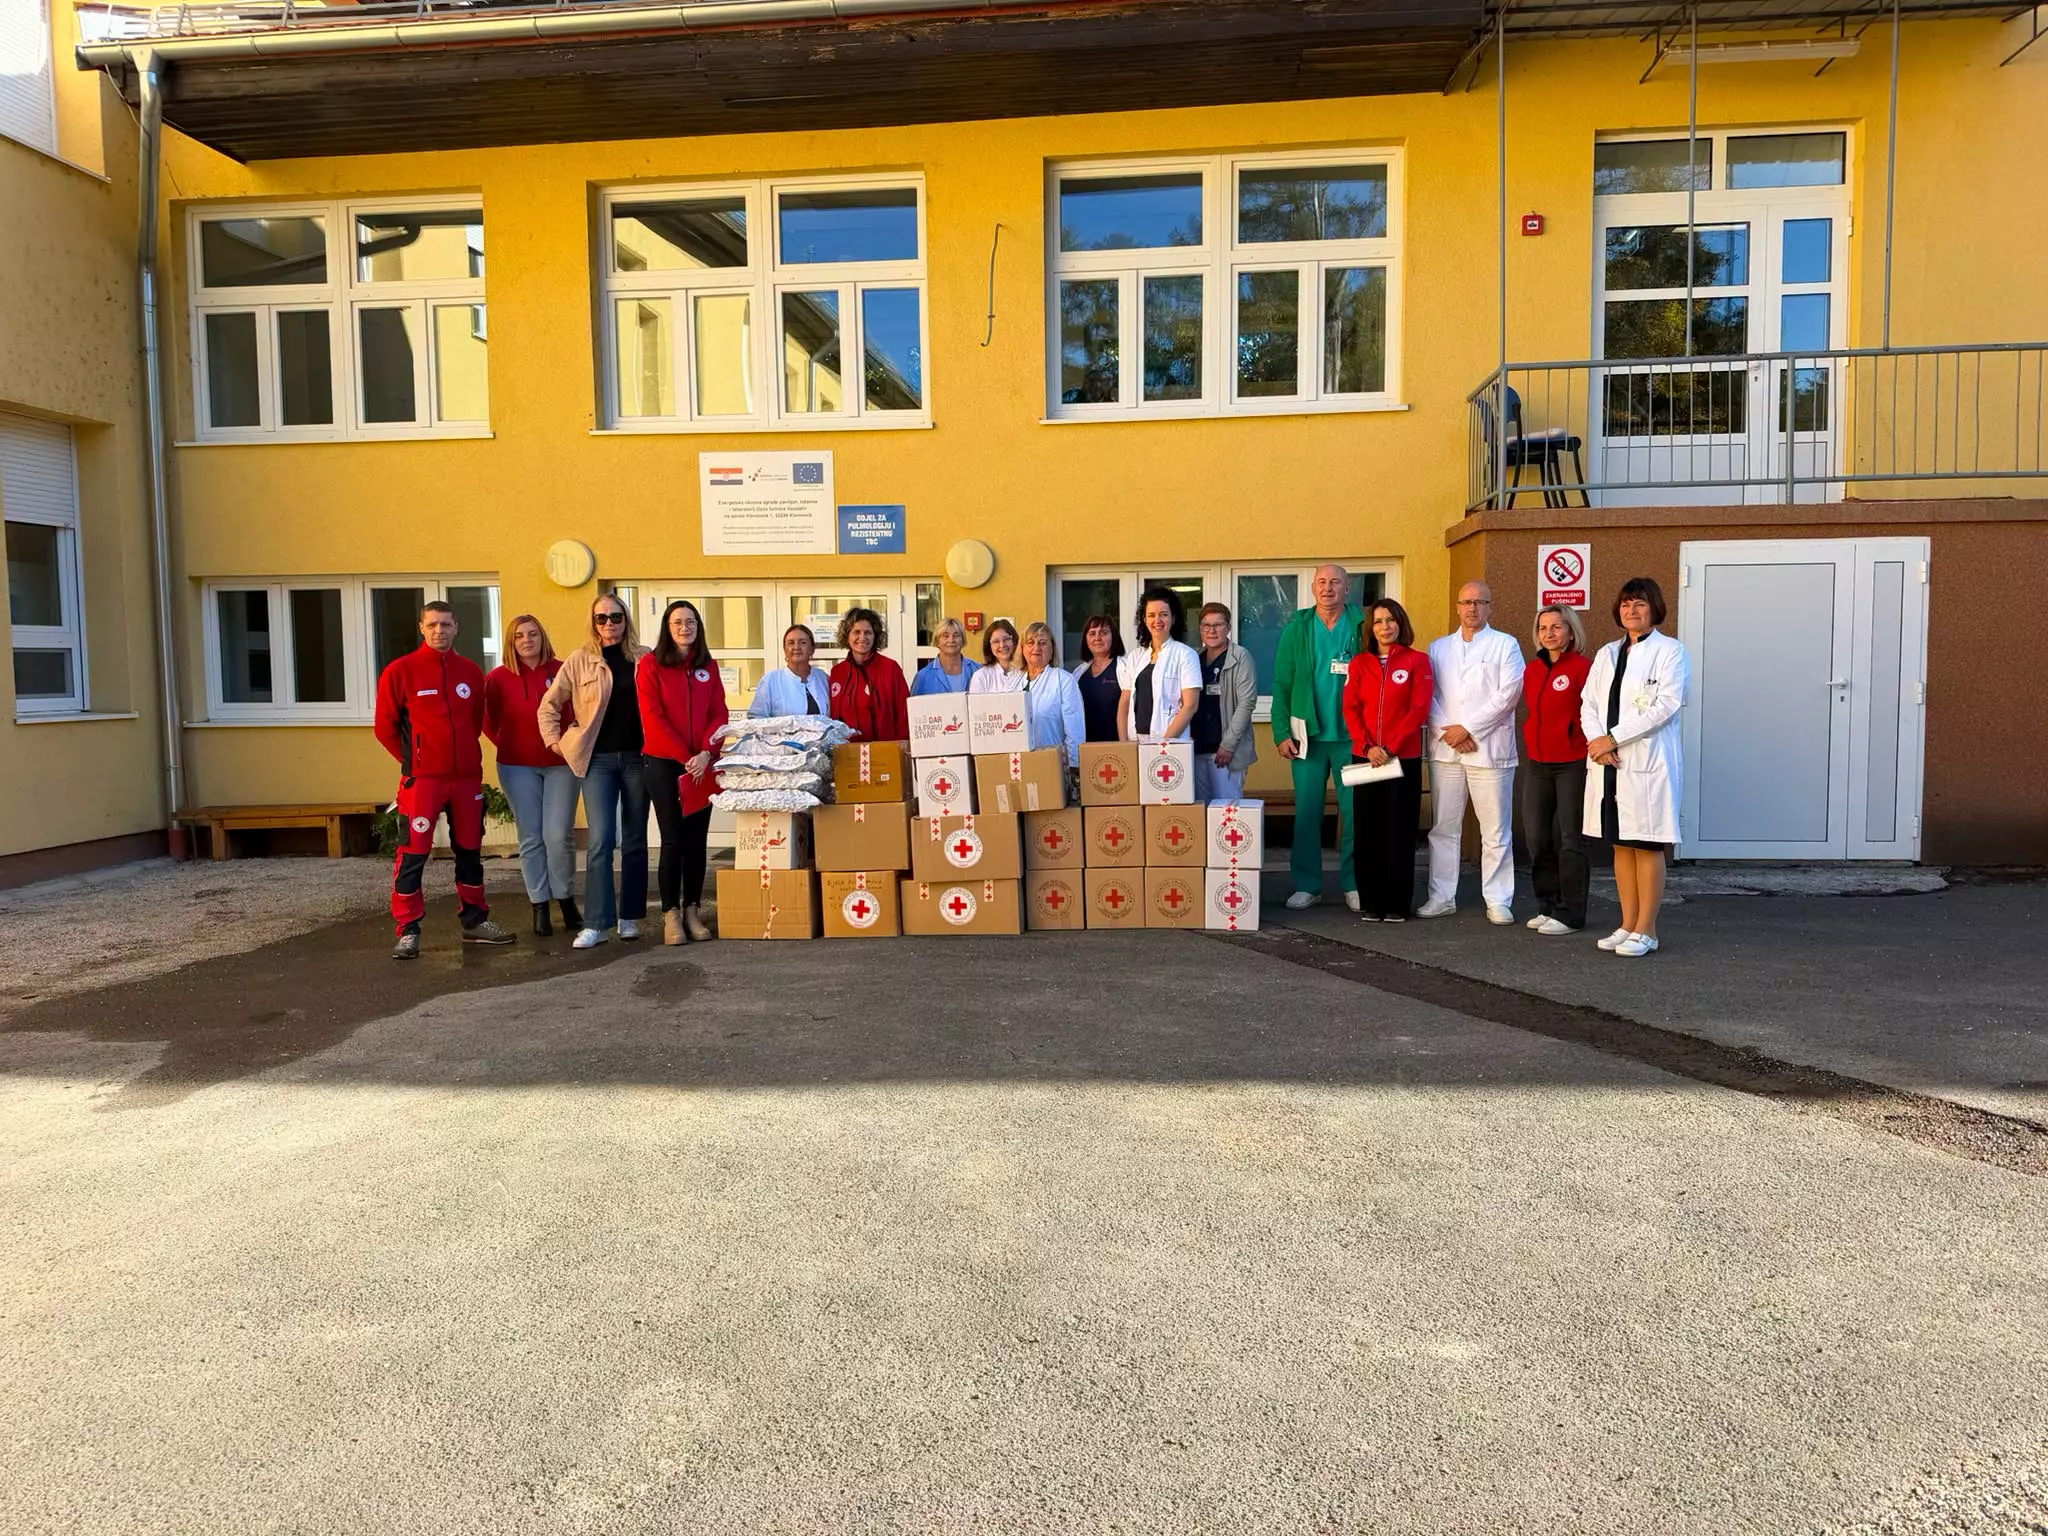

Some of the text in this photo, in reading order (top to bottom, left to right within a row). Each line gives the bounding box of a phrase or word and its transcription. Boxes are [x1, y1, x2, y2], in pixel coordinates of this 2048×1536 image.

[848, 522, 891, 530] PULMOLOGIJU
[851, 530, 893, 538] REZISTENTNU
[929, 715, 943, 723] DAR
[923, 724, 943, 732] PRAVU
[974, 721, 1002, 730] ZA PRAVU
[915, 731, 935, 739] STVAR
[975, 728, 995, 736] STVAR
